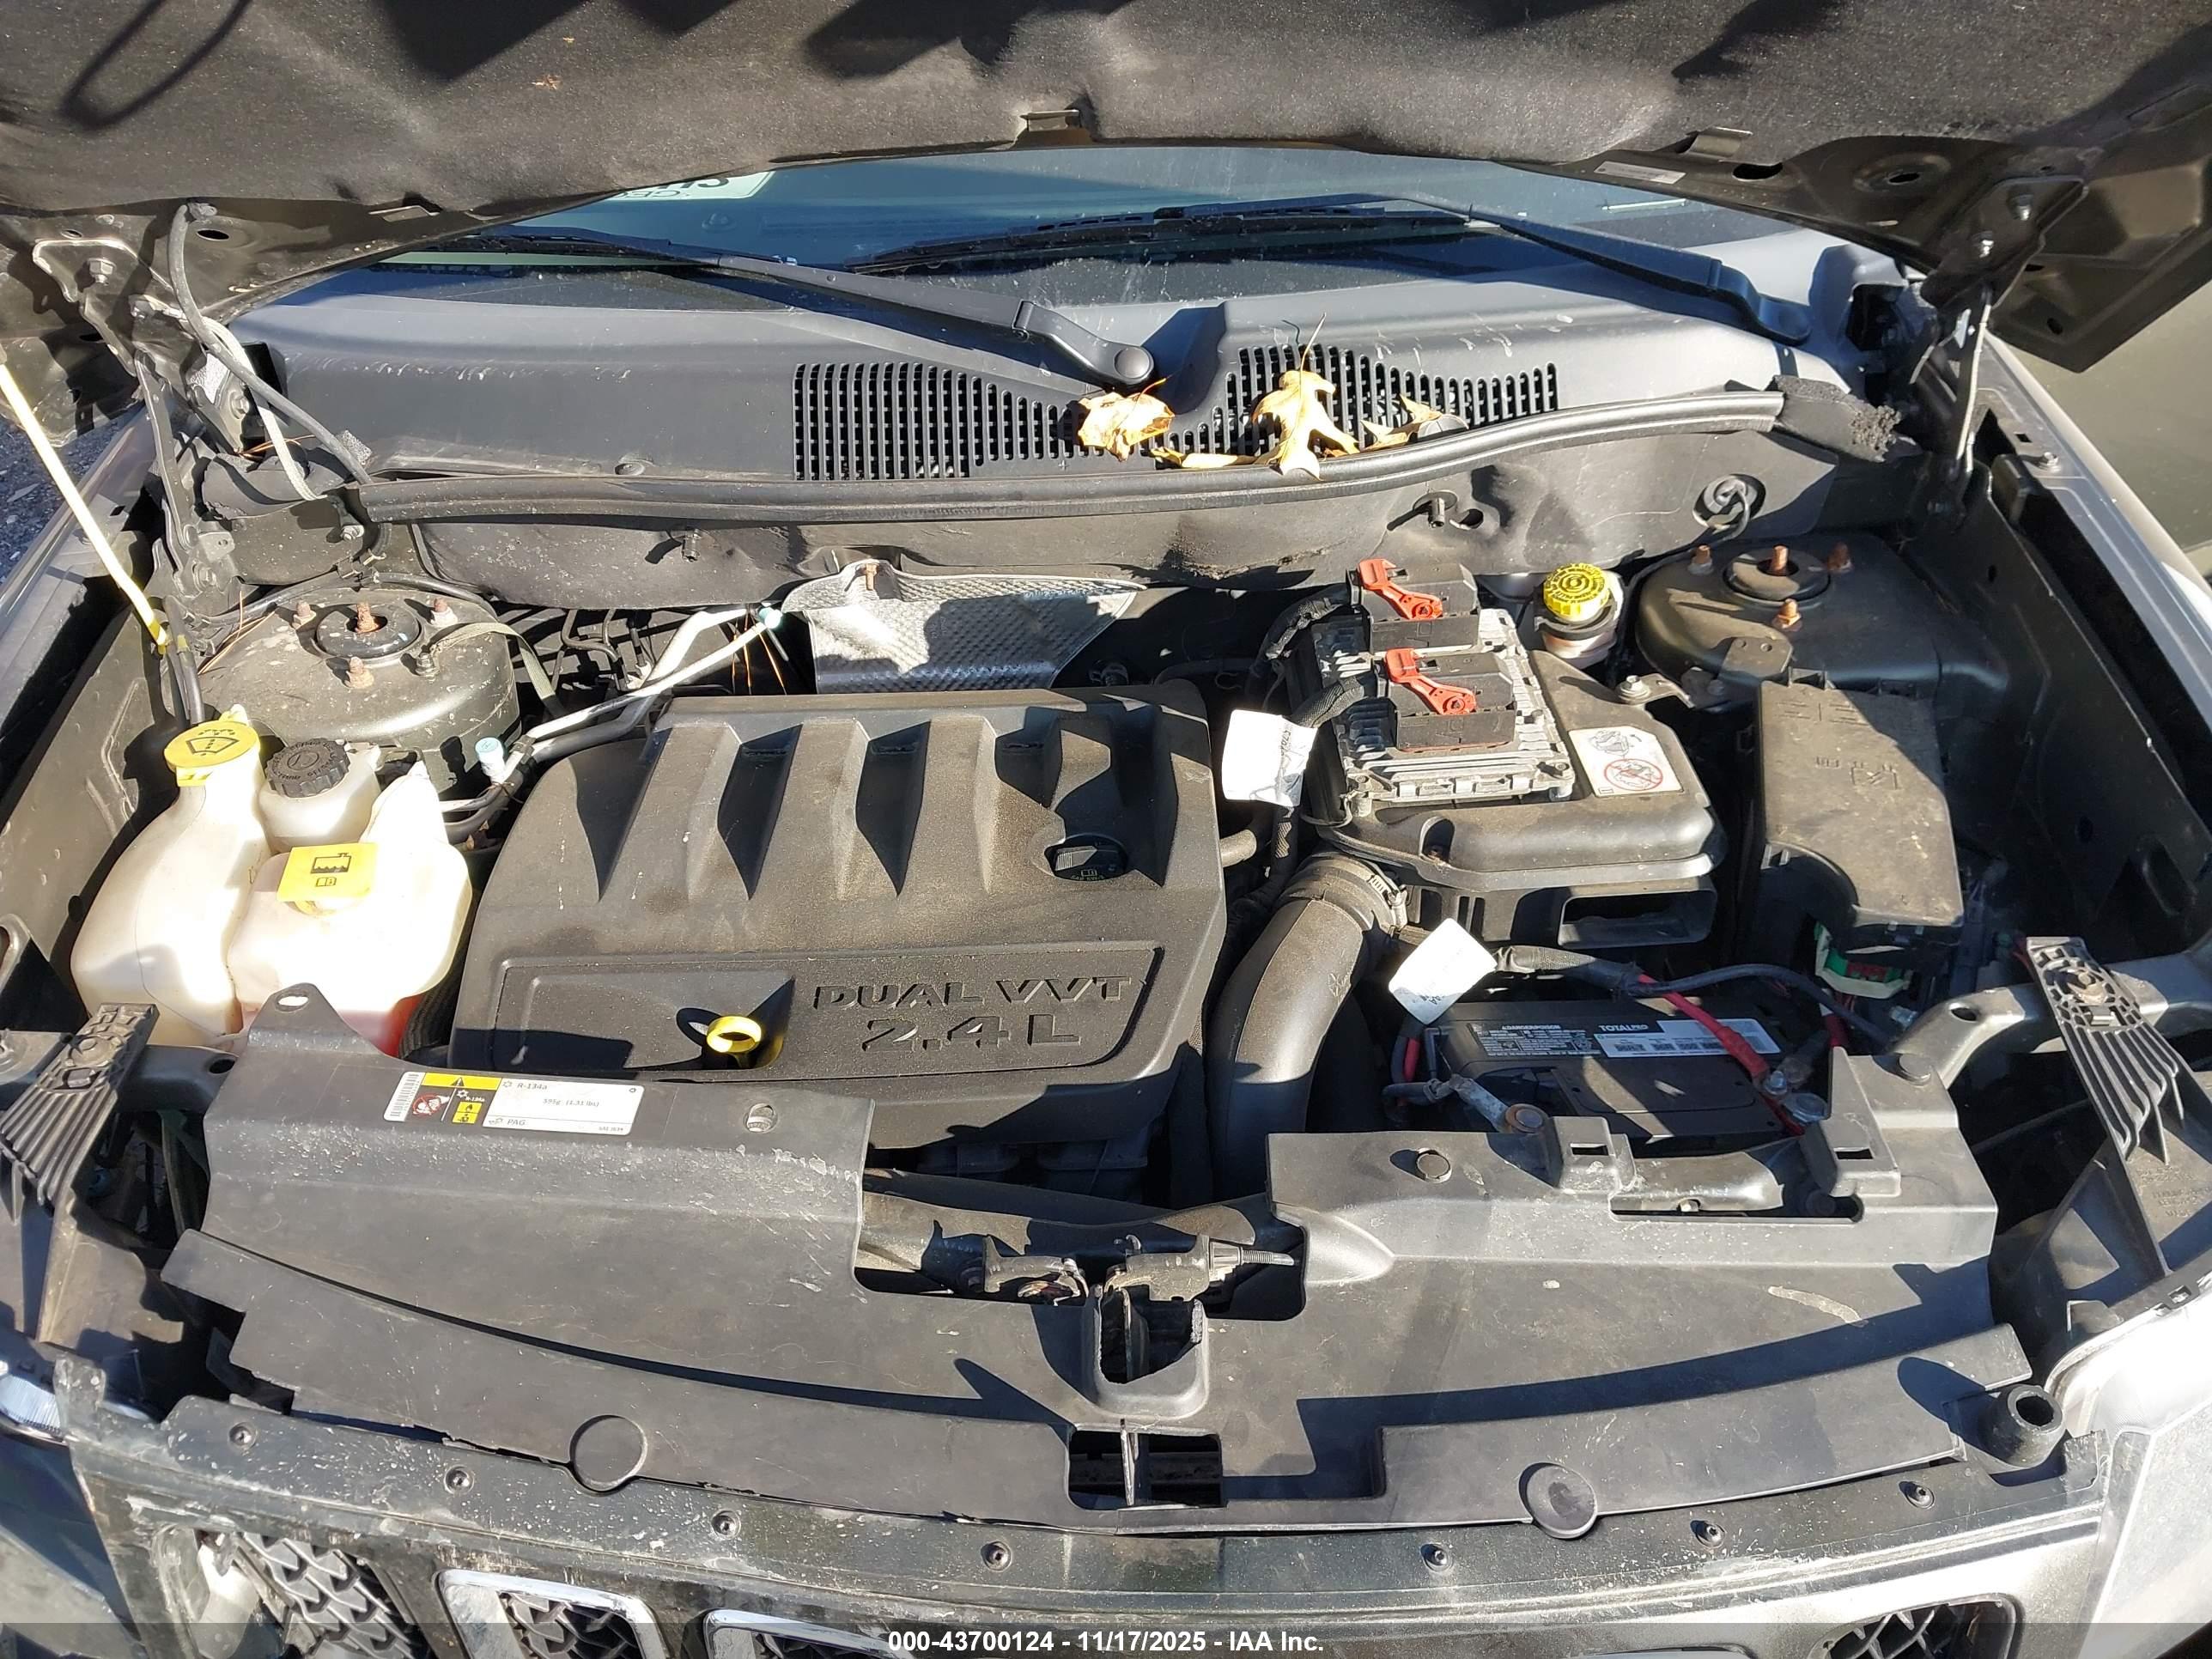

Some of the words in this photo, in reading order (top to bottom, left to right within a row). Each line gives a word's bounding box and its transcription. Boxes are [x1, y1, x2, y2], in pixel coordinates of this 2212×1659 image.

[813, 981, 985, 1010] DUAL
[996, 976, 1130, 1004] VVT
[862, 1014, 1080, 1052] 2.4L
